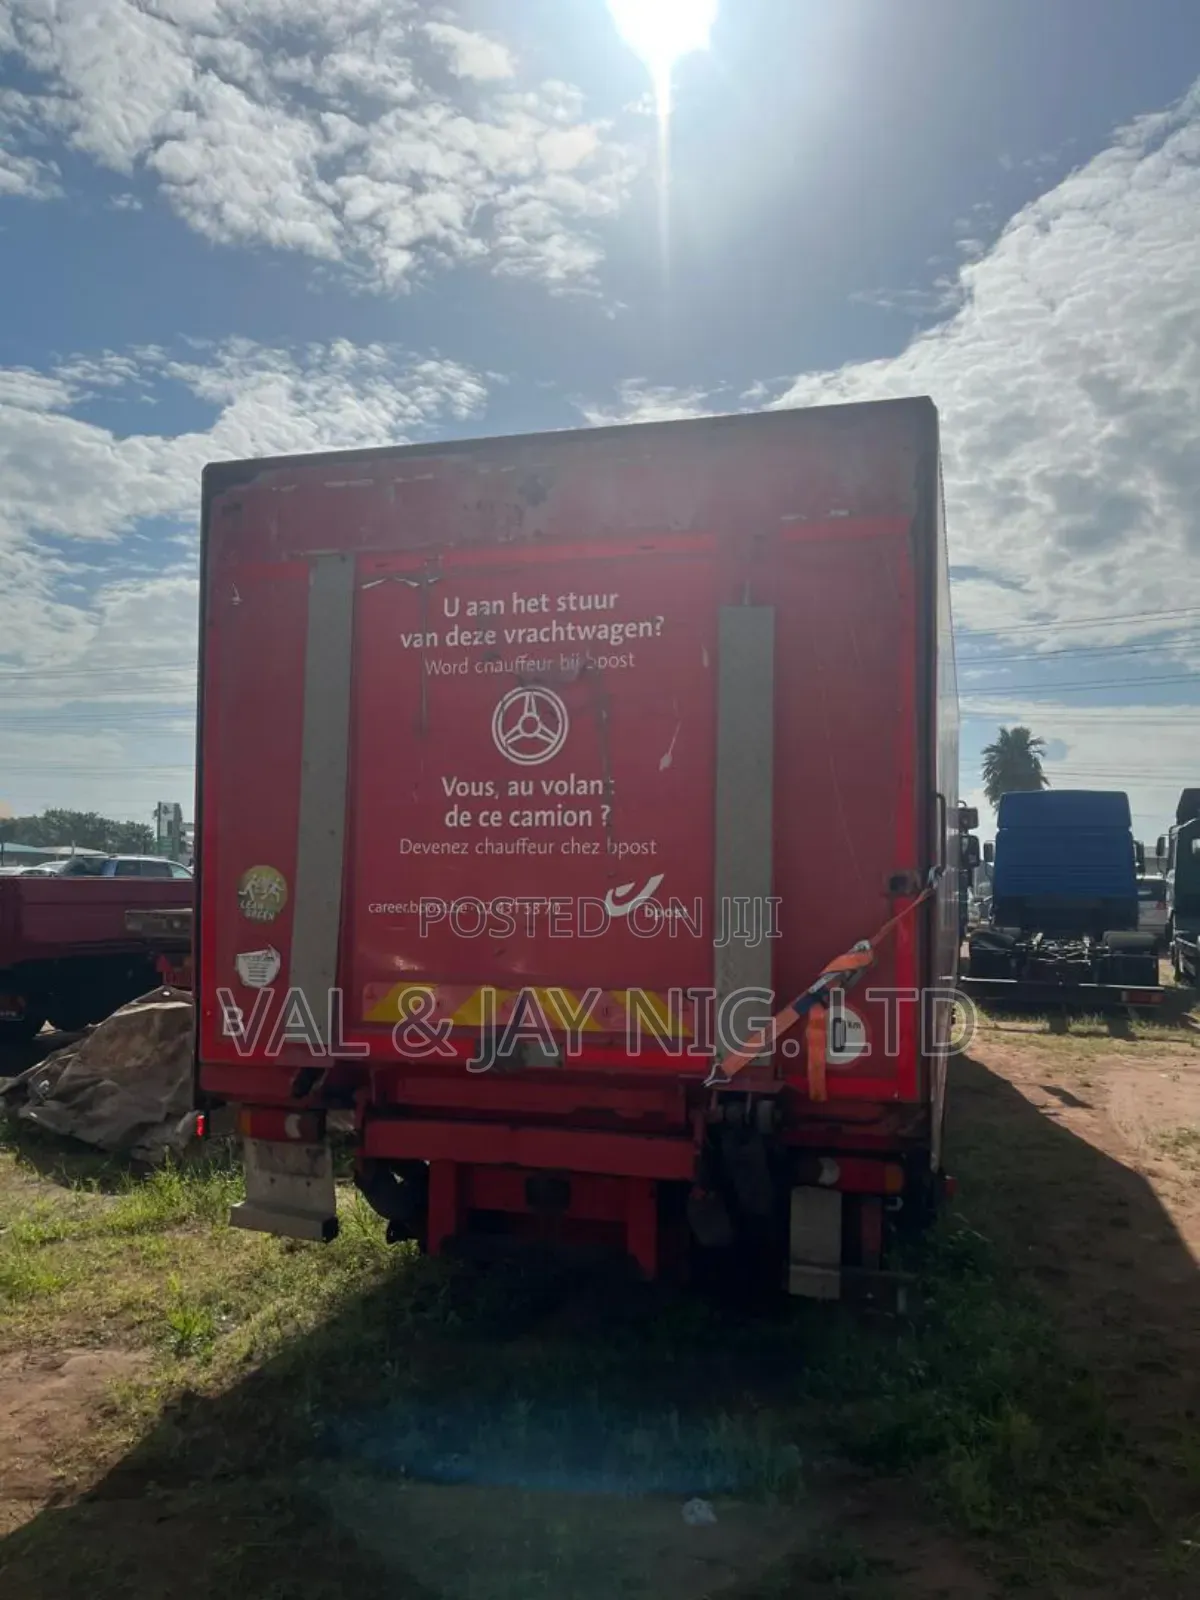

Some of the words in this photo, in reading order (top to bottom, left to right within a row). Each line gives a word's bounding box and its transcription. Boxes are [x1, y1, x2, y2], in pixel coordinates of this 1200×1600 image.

[443, 597, 460, 617] U
[466, 598, 505, 617] aan
[512, 592, 550, 614] het
[556, 591, 620, 612] stuur
[400, 629, 438, 648] van
[446, 625, 497, 646] deze
[504, 615, 665, 645] vrachtwagen?
[424, 657, 469, 674] Word
[560, 652, 581, 671] bij
[441, 776, 498, 800] Vous,
[507, 779, 534, 796] au
[445, 804, 472, 827] de
[479, 809, 502, 827] ce
[509, 803, 592, 827] camion
[600, 804, 611, 827] ?
[400, 838, 469, 855] Devenez
[475, 836, 555, 855] chauffeur
[560, 836, 600, 855] chez
[606, 837, 657, 860] bpost
[643, 904, 688, 921] bpost
[223, 1007, 243, 1036] B
